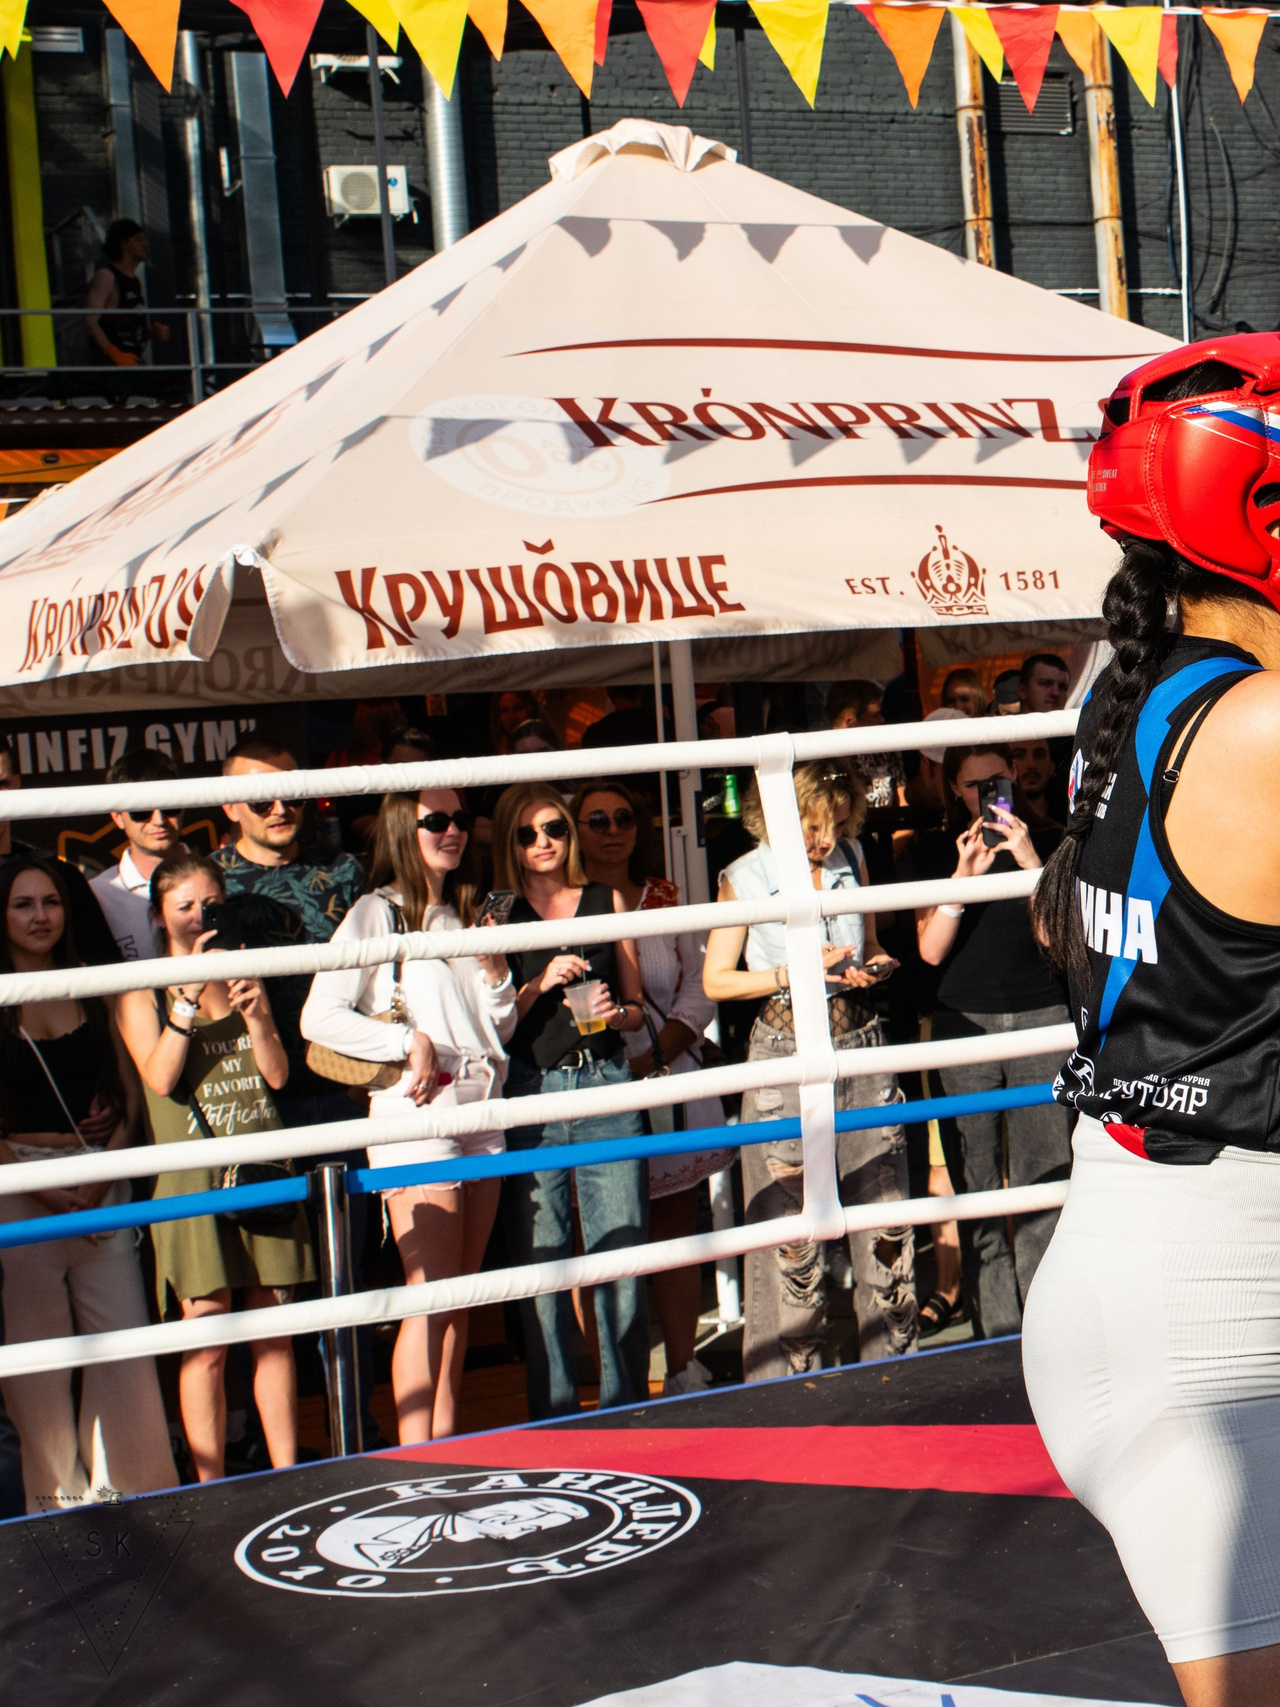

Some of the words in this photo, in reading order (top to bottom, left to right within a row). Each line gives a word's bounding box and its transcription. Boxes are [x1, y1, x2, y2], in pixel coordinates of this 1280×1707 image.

[545, 388, 1111, 448] KRÓNPRINZ
[844, 576, 905, 596] EST.
[999, 569, 1060, 593] 1581
[222, 1057, 242, 1074] MY
[203, 1075, 263, 1099] FAVORIT
[386, 1471, 683, 1576] КАНЦЛЕРЪ
